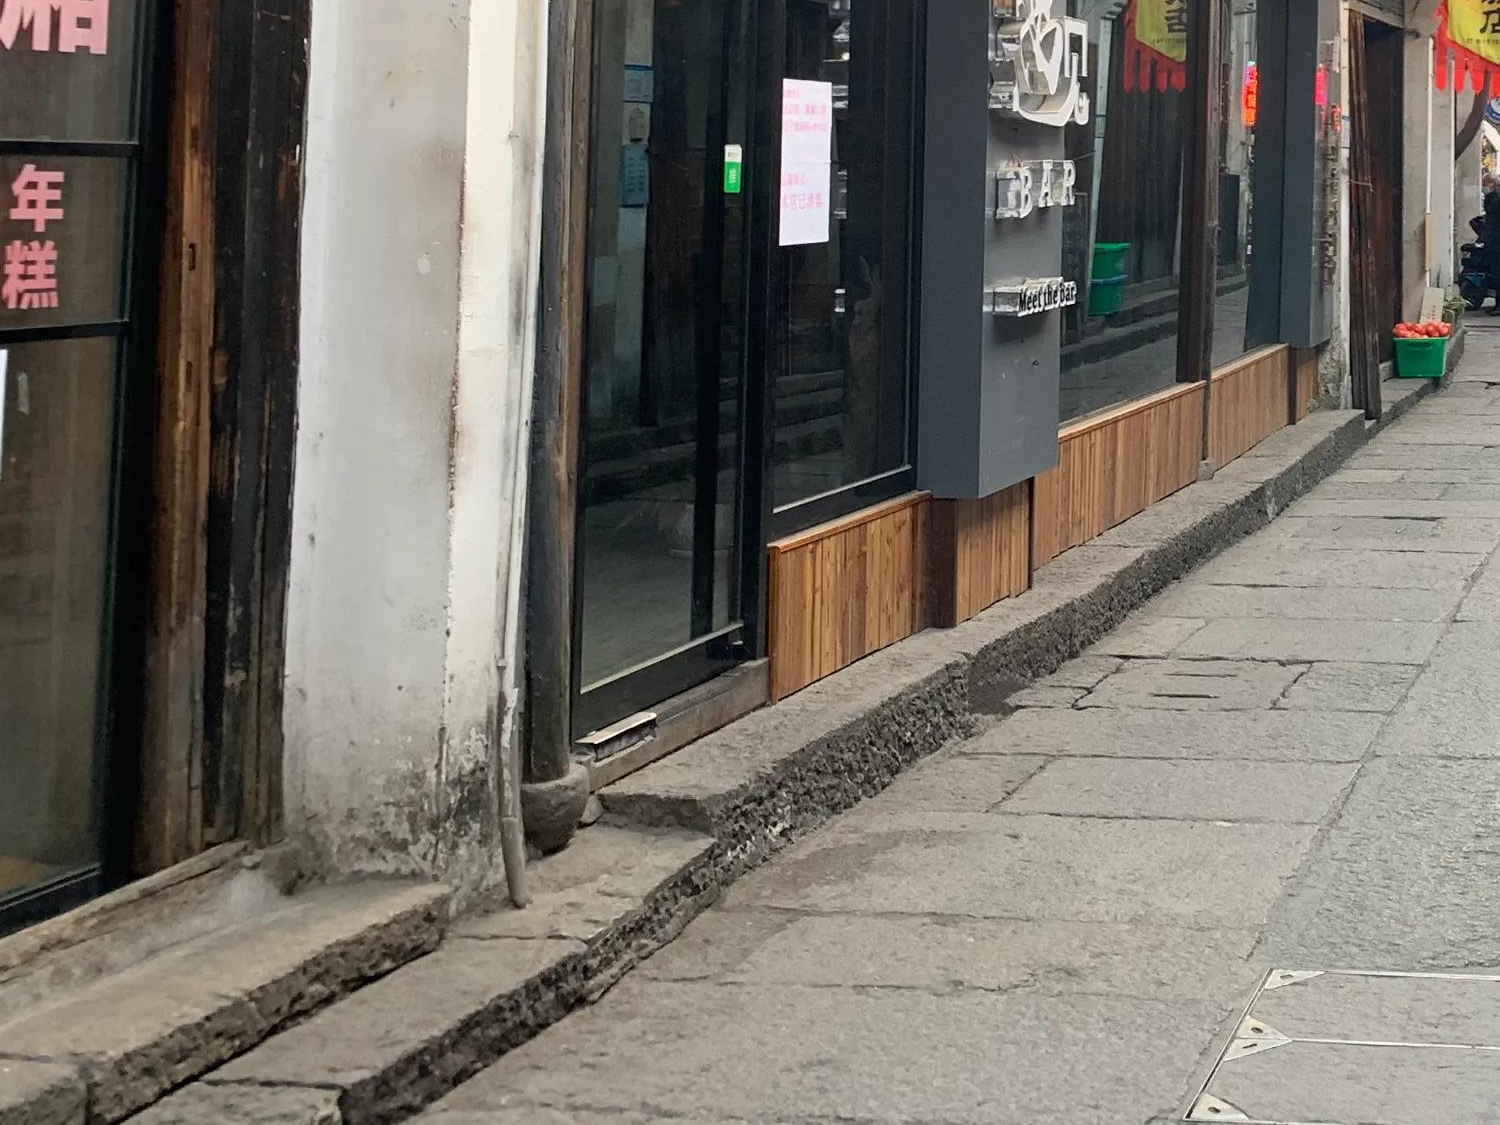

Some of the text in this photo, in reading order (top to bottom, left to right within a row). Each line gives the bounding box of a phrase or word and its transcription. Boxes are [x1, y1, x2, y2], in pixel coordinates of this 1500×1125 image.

[1018, 159, 1077, 219] BAR
[2, 164, 64, 309] 年糕
[1019, 280, 1076, 312] Meet the bar
